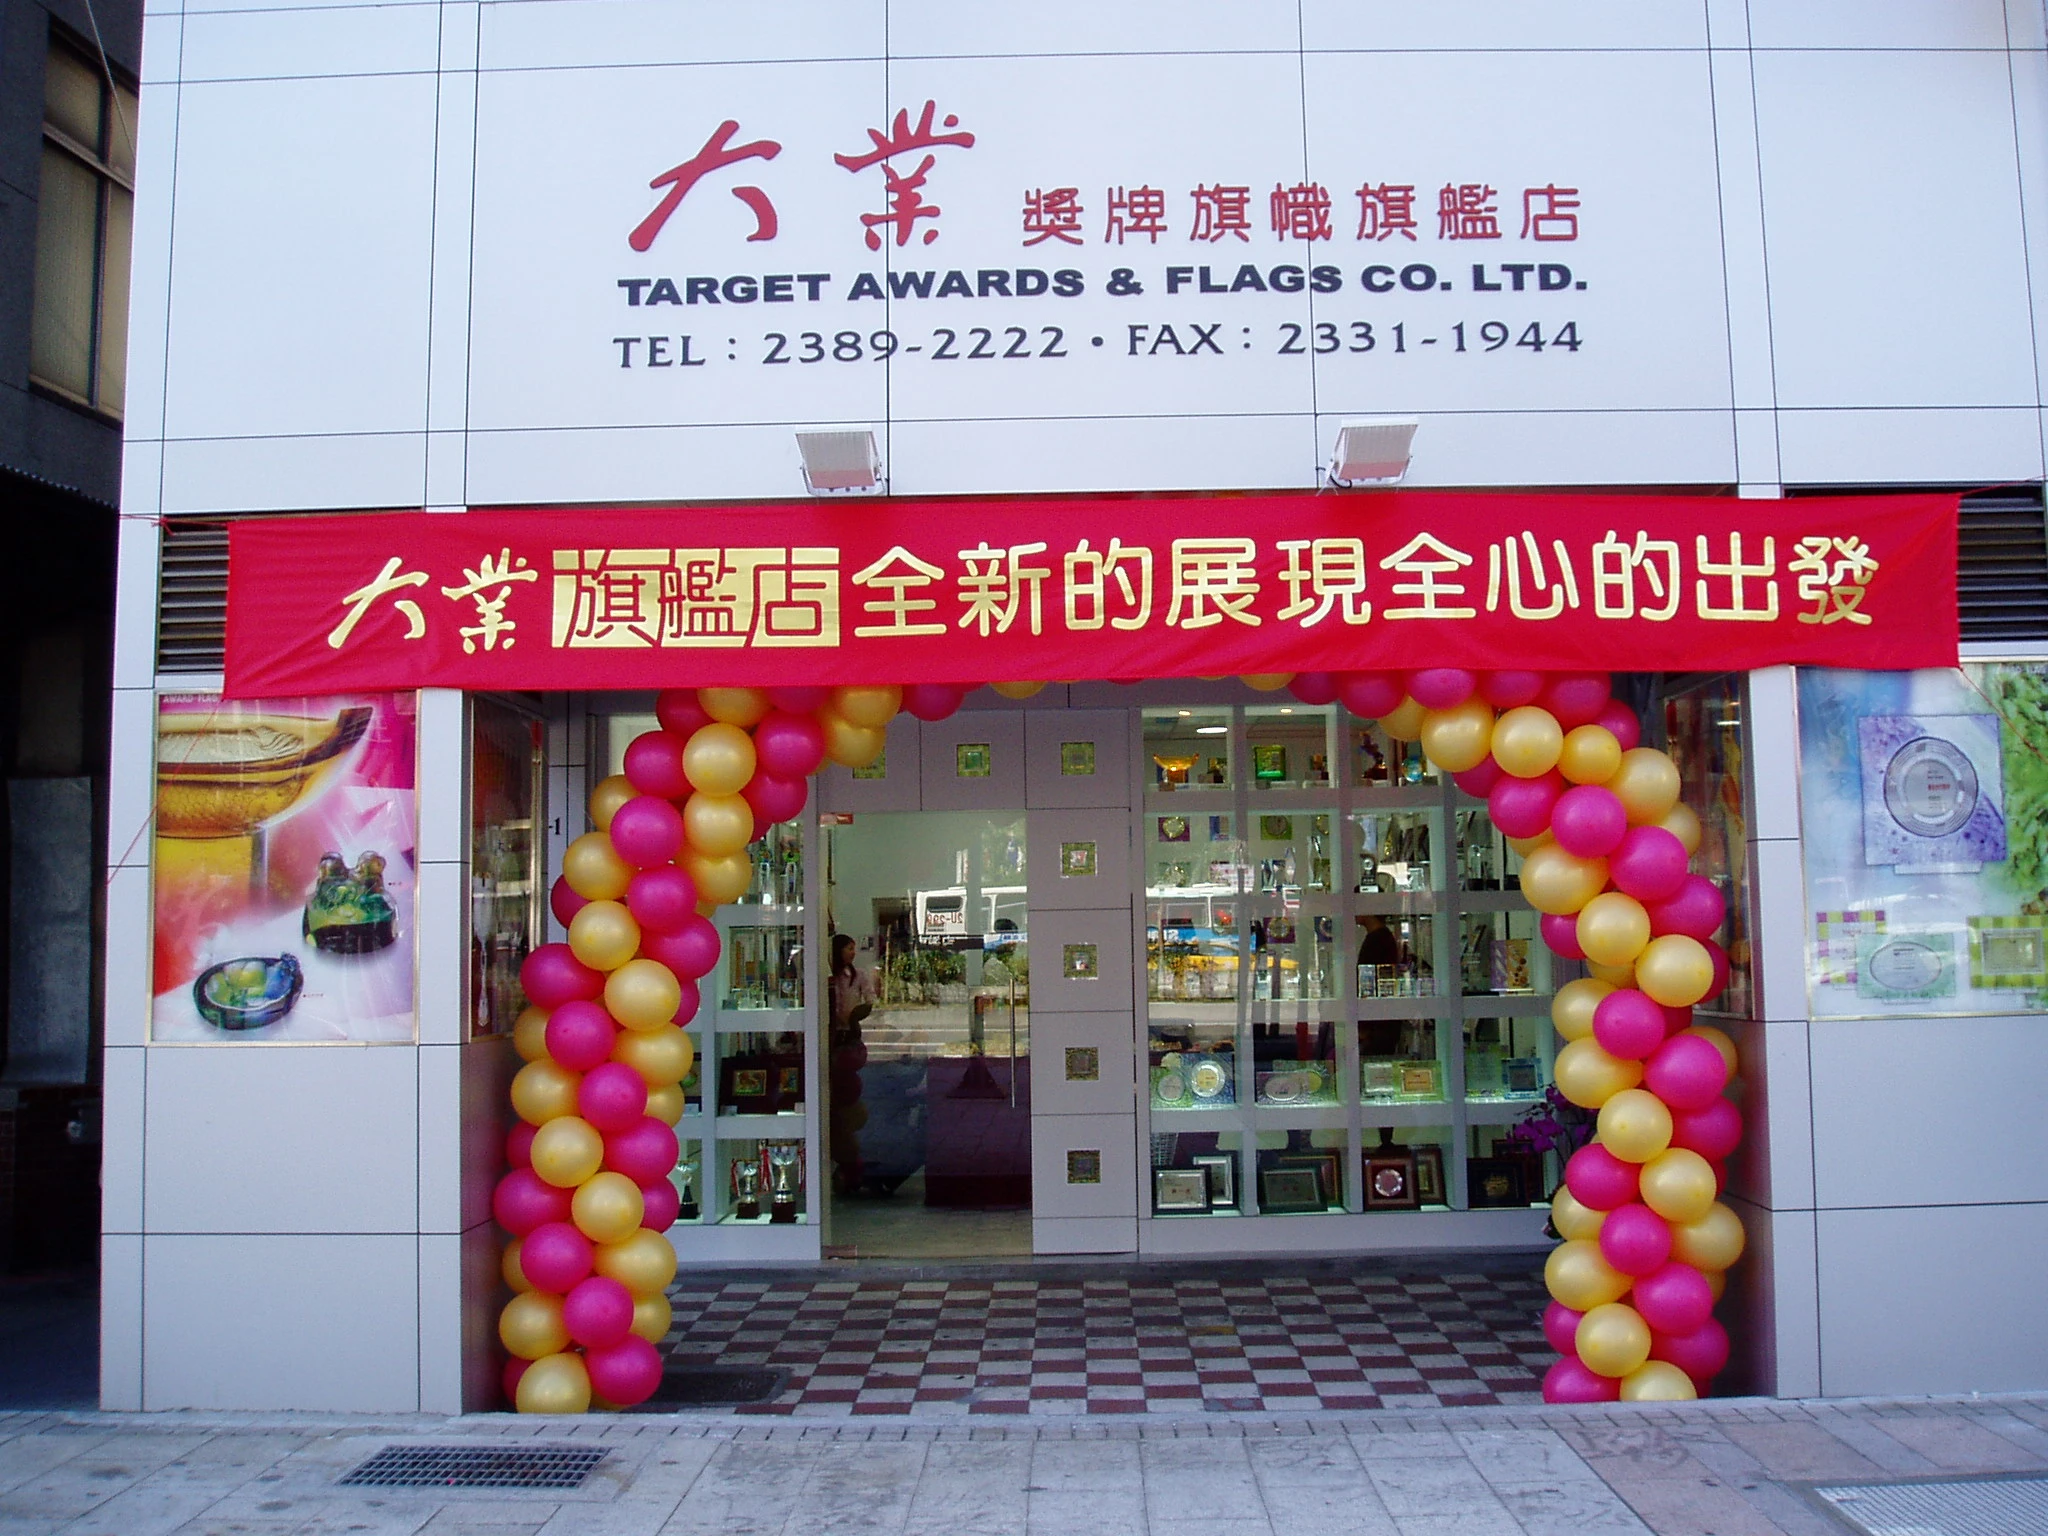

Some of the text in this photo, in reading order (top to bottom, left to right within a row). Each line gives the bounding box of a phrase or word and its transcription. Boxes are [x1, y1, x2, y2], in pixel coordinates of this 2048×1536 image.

[629, 100, 975, 252] 大業
[618, 263, 1588, 306] TARGET AWARDS & FLAGS CO. LTD.
[762, 327, 1068, 365] 2389-2222
[1278, 321, 1583, 354] 2331-1944
[327, 530, 1880, 655] 大業 旗艦店 全新的展現全心的出發
